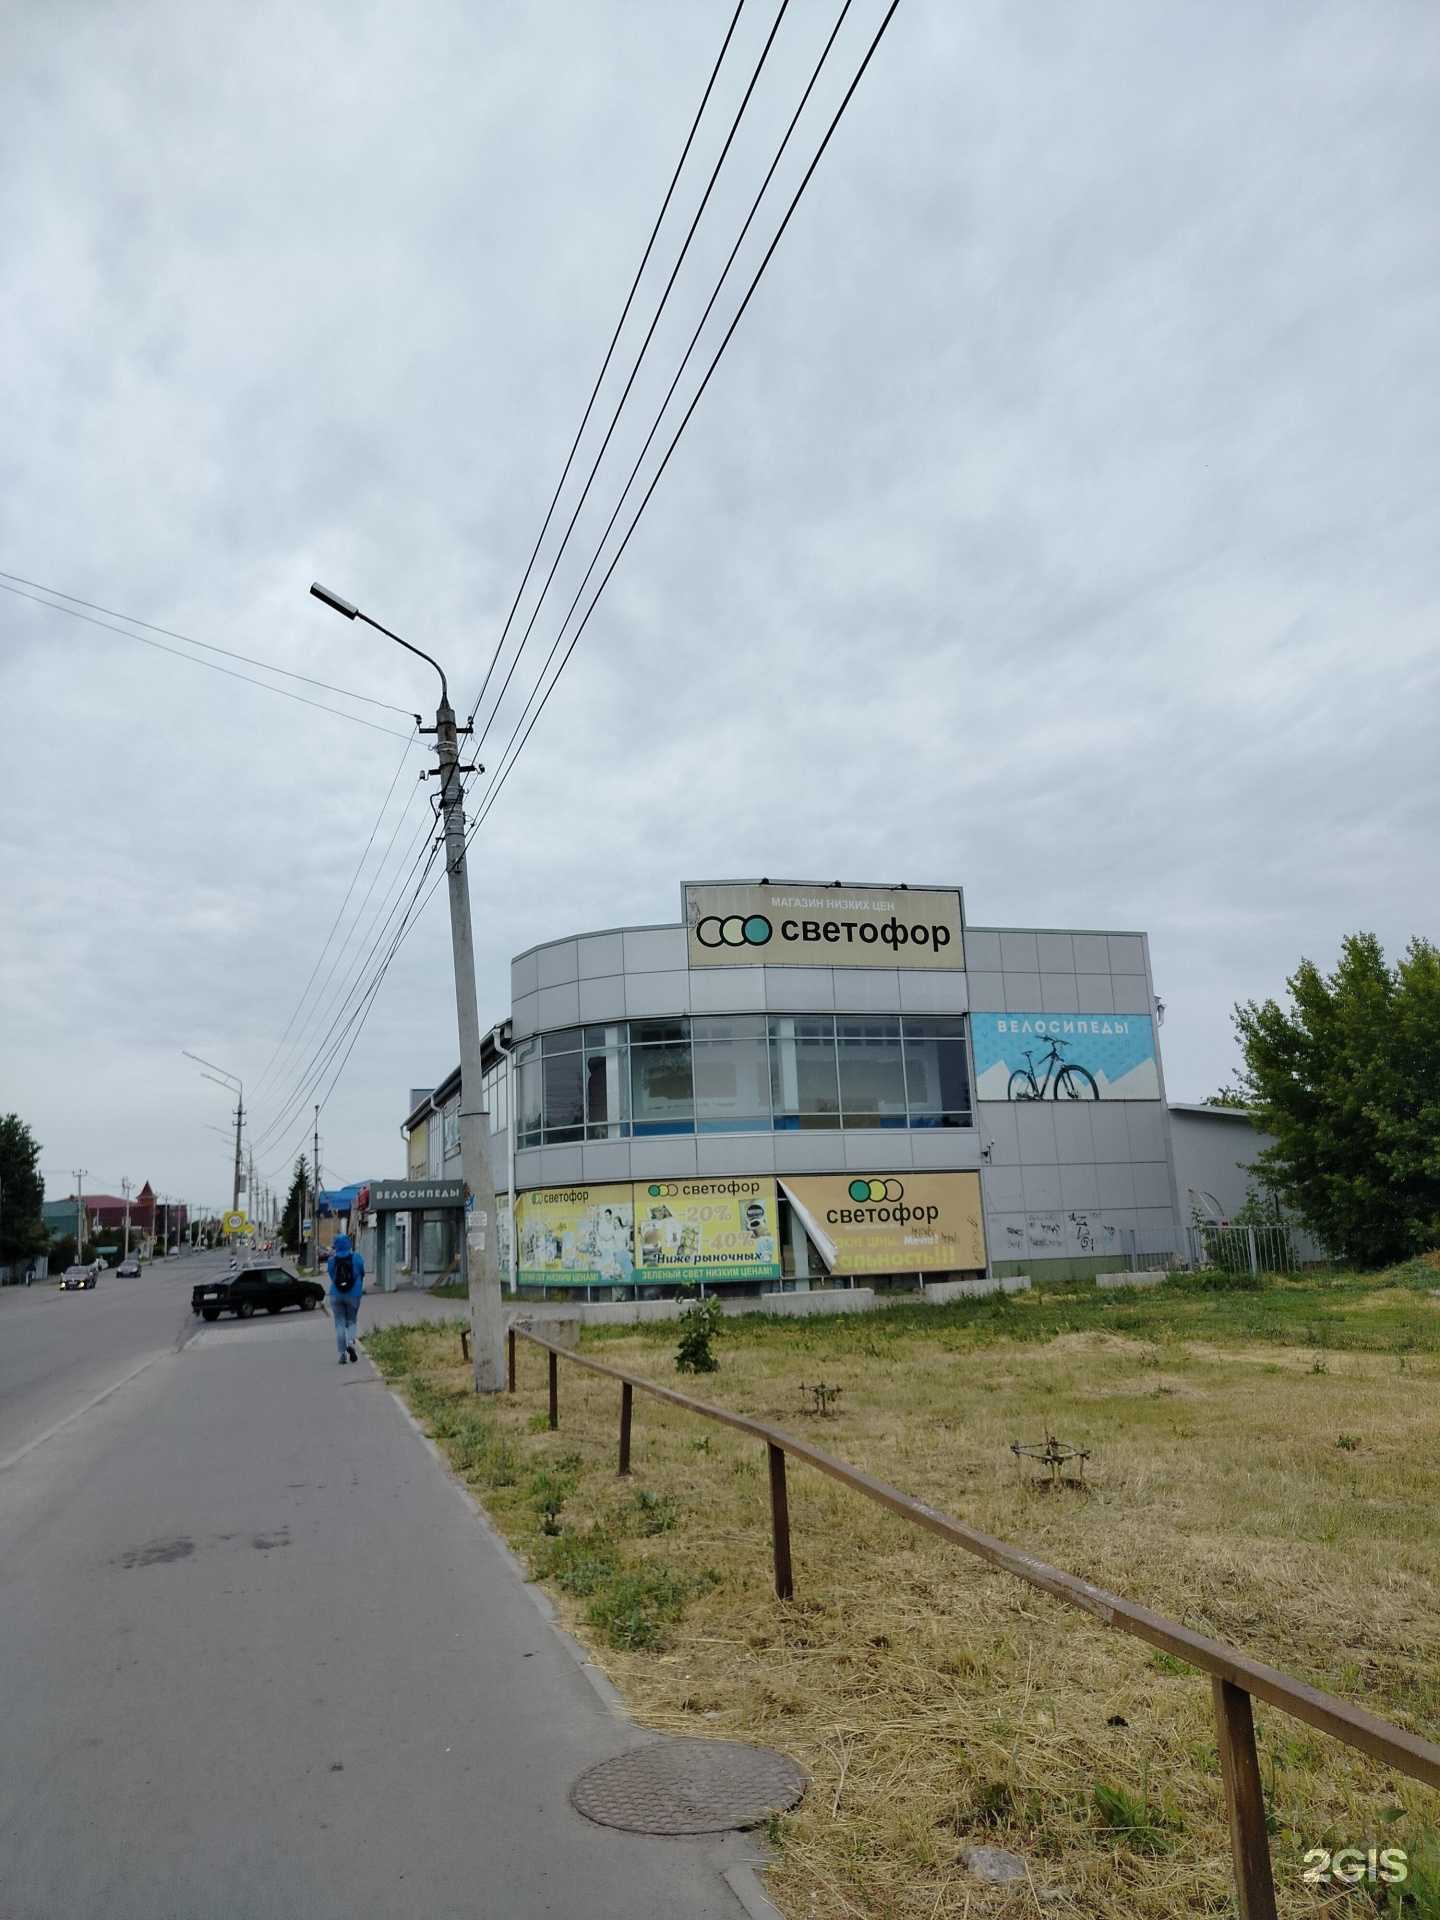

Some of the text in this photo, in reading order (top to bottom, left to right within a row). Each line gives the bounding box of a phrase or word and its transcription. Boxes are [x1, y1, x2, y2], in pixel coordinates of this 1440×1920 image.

[771, 896, 895, 912] МАГАЗИН НИЗКИХ ЦЕН
[781, 916, 950, 952] светофор
[997, 1020, 1129, 1034] ВЕЛОСИПЕДЫ
[376, 1188, 460, 1200] ВЕЛОСИПЕДЫ
[683, 1180, 760, 1196] светофор
[544, 1190, 588, 1204] светофор
[827, 1203, 938, 1225] светофор
[654, 1251, 762, 1266] Ниже рыночных
